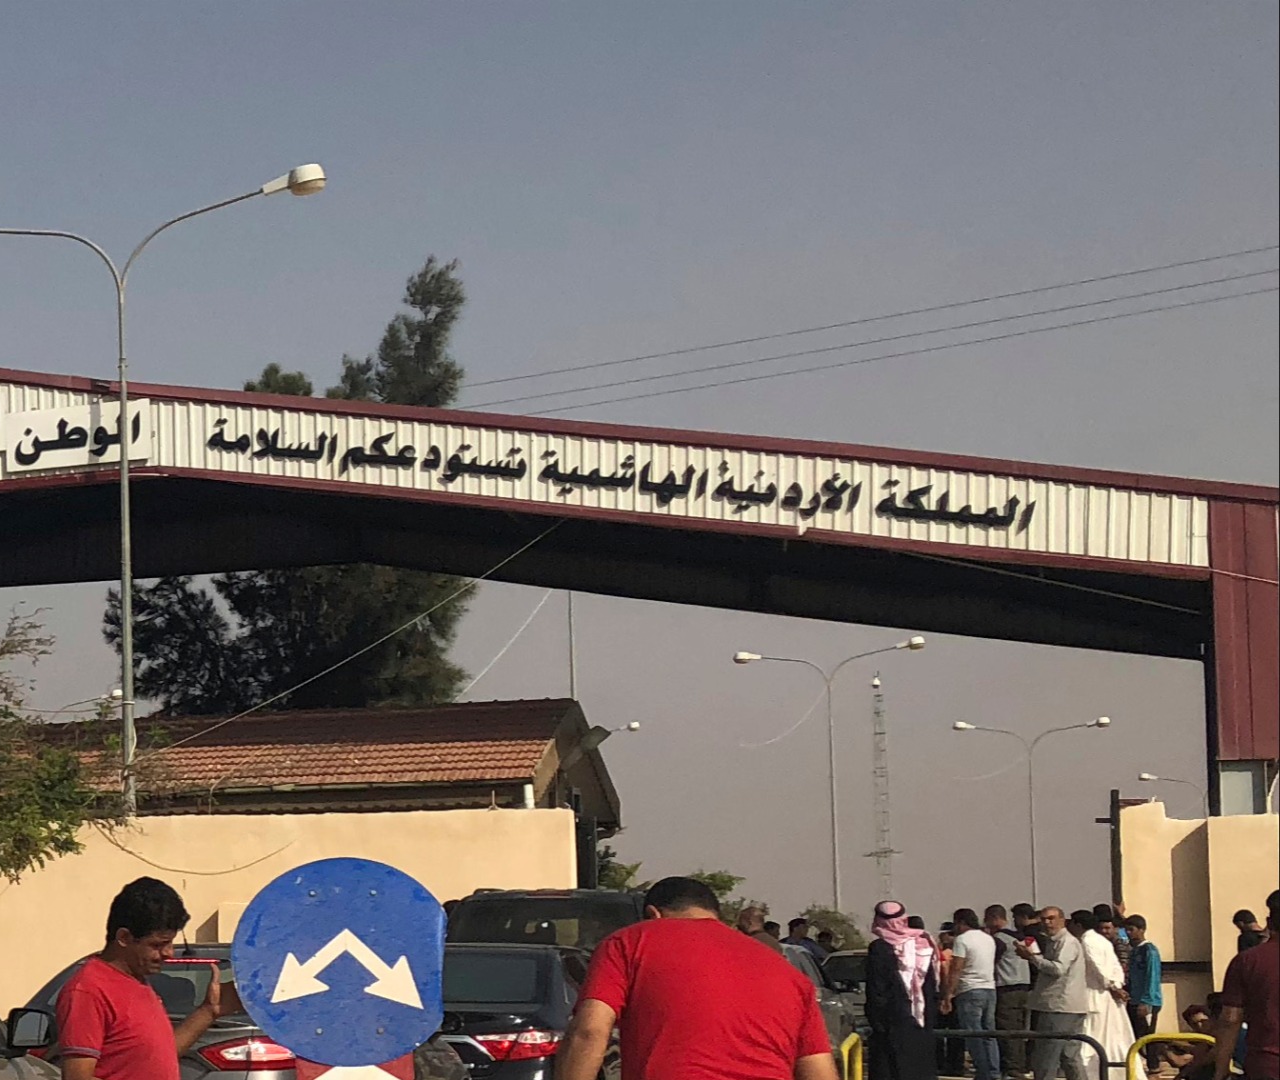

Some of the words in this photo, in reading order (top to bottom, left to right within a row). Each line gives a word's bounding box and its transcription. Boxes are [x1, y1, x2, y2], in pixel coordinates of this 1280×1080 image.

[14, 410, 141, 466] الوطن
[205, 418, 338, 466] السلامة
[339, 430, 528, 484] تستودعكم
[538, 449, 709, 508] الهاشمية
[711, 459, 863, 522] الأردنية
[874, 478, 1036, 536] المملكة
